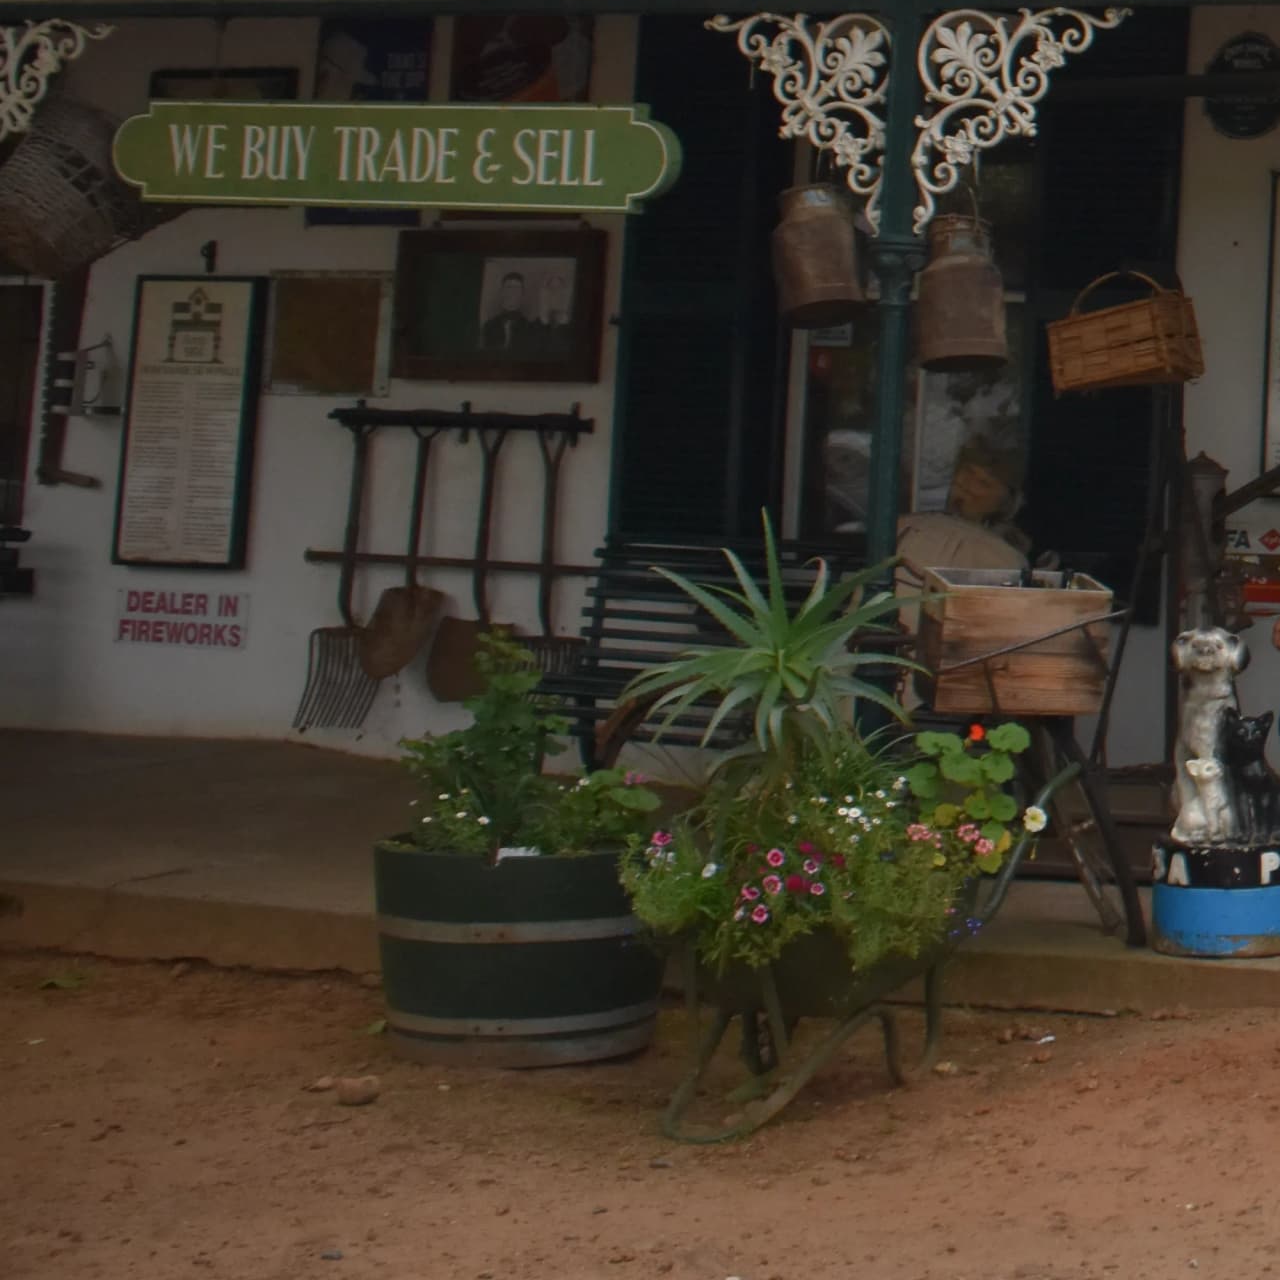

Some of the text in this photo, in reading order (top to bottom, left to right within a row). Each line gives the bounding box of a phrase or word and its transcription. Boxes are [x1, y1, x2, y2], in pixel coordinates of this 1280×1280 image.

[168, 122, 606, 188] WE BUY TRADE & SELL
[126, 589, 240, 618] DEALER IN
[118, 618, 242, 648] FIREWORKS
